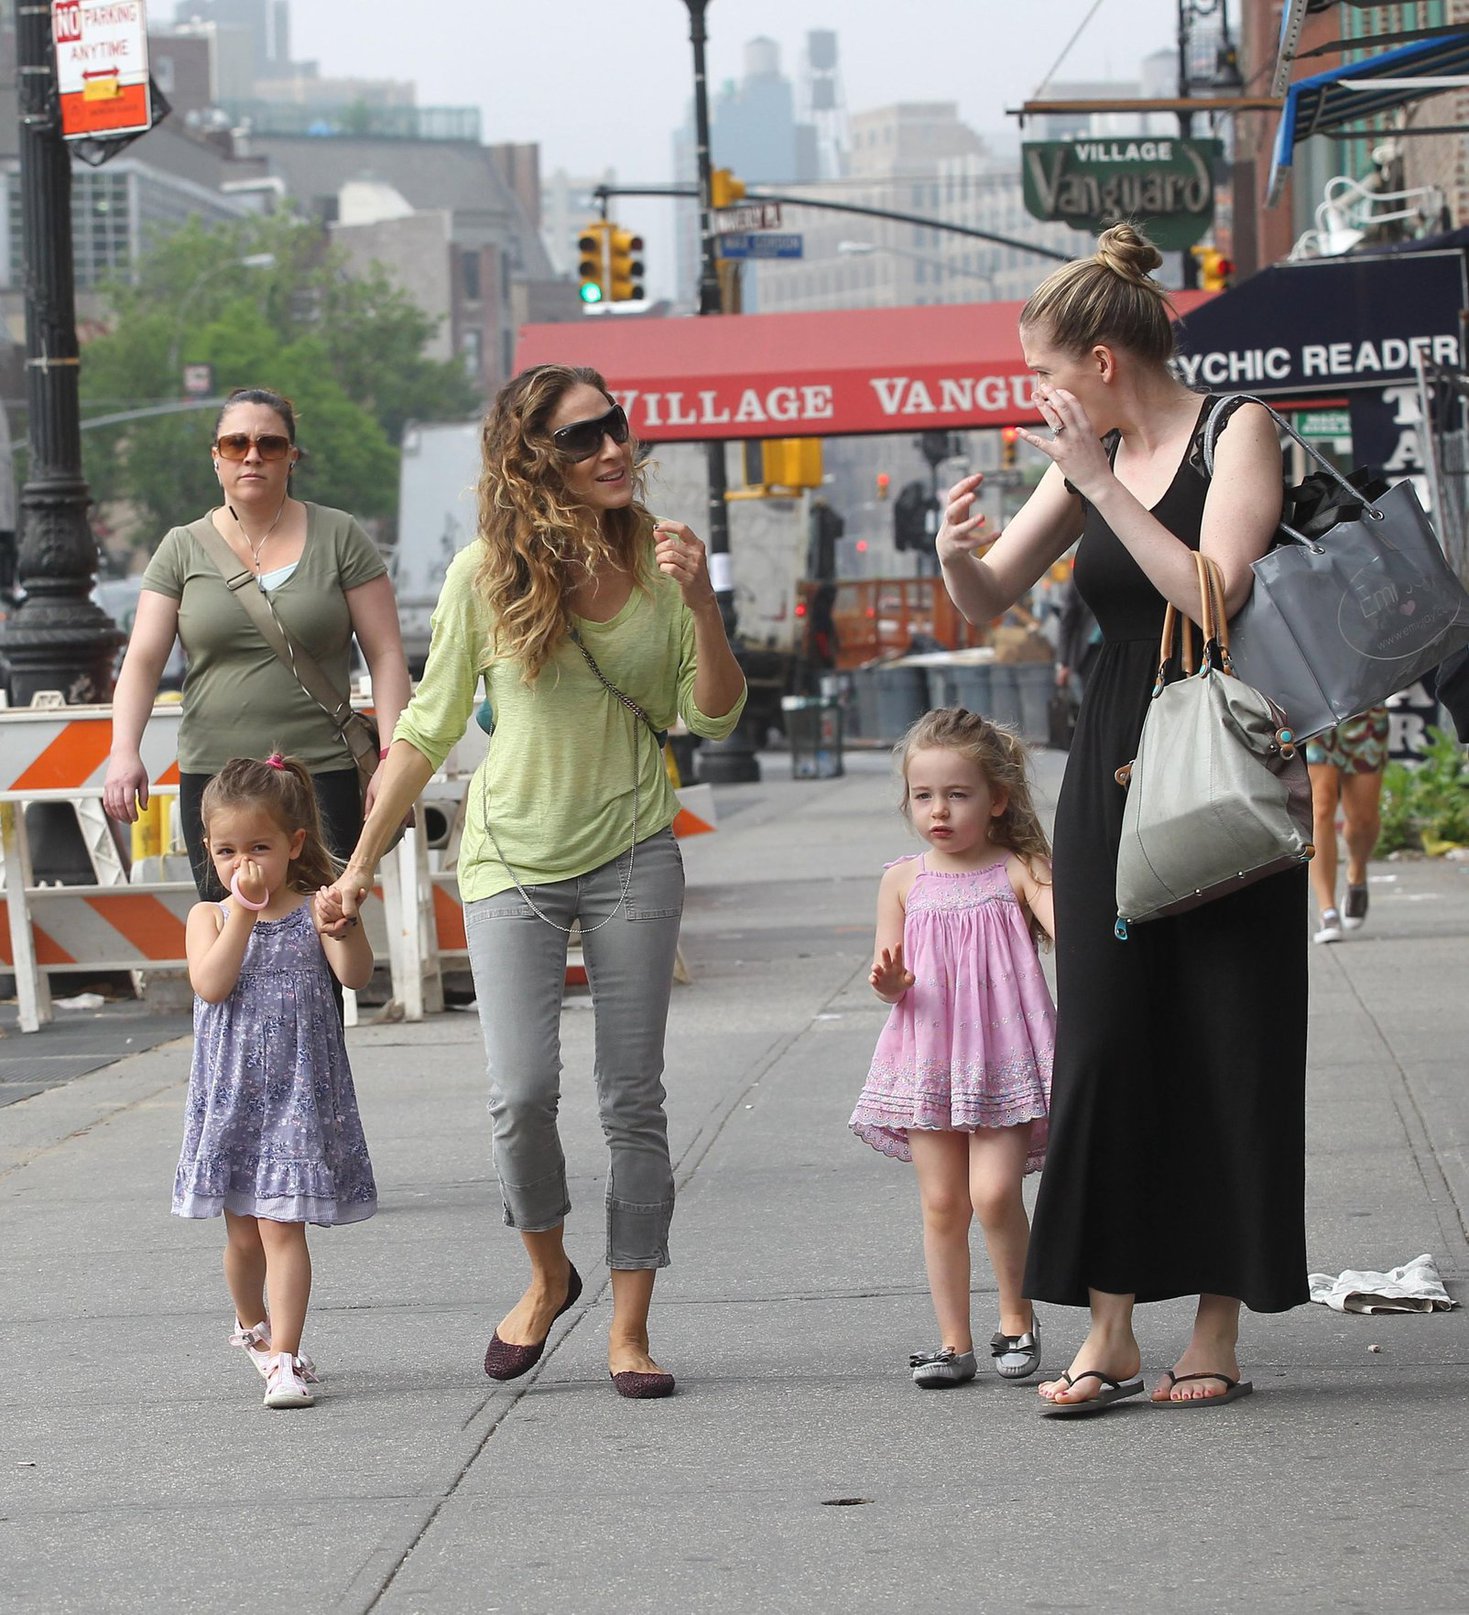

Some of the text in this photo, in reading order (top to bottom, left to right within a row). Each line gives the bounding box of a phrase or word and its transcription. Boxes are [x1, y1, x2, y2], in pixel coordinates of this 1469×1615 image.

[56, 4, 138, 38] NO PARKING
[71, 39, 130, 61] ANYTIME
[1074, 141, 1173, 162] VILLAGE
[1027, 144, 1211, 220] Vanguard
[1302, 335, 1460, 377] READER
[608, 384, 834, 426] VILLAGE
